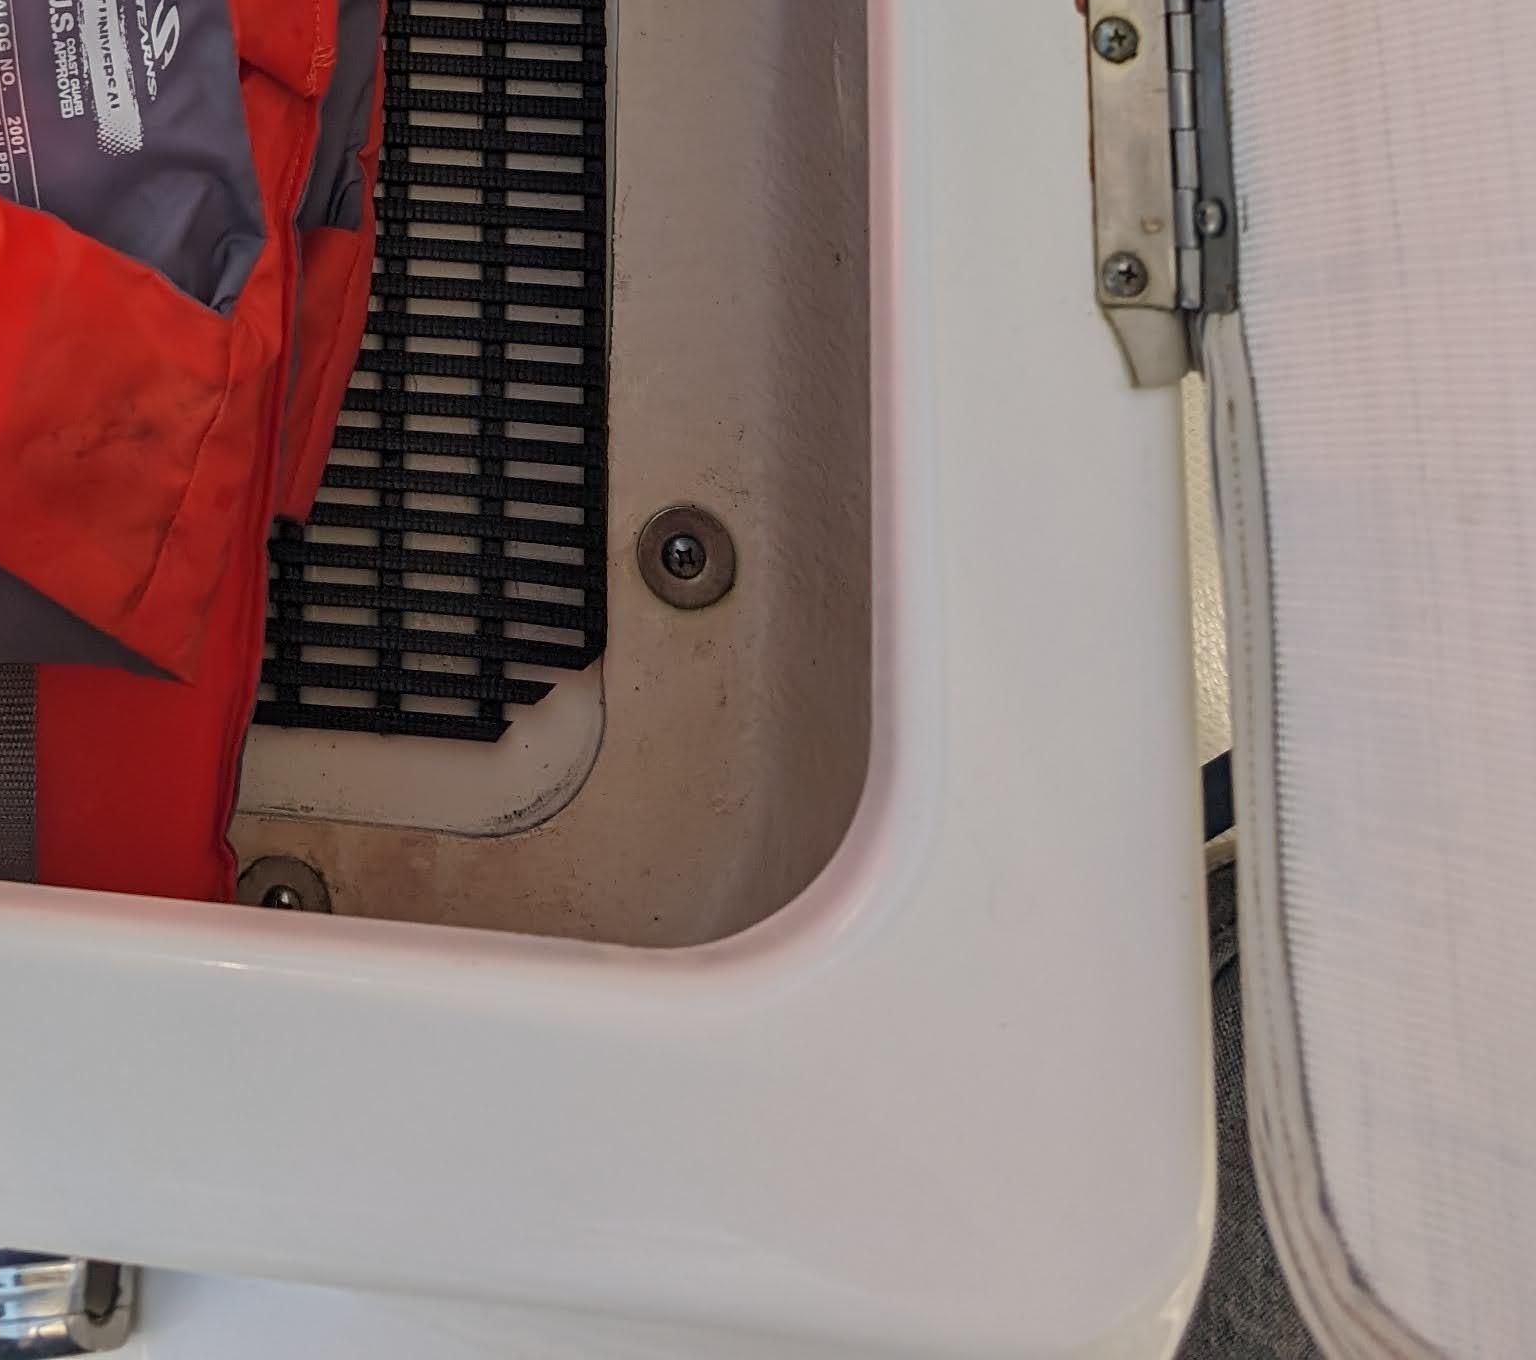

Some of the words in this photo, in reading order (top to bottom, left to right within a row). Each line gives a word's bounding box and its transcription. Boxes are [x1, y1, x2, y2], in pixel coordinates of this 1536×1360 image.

[53, 40, 74, 118] APPROVED
[66, 38, 79, 75] COAST
[0, 58, 15, 92] NO.
[8, 116, 25, 155] 2001
[70, 78, 84, 115] GUARD
